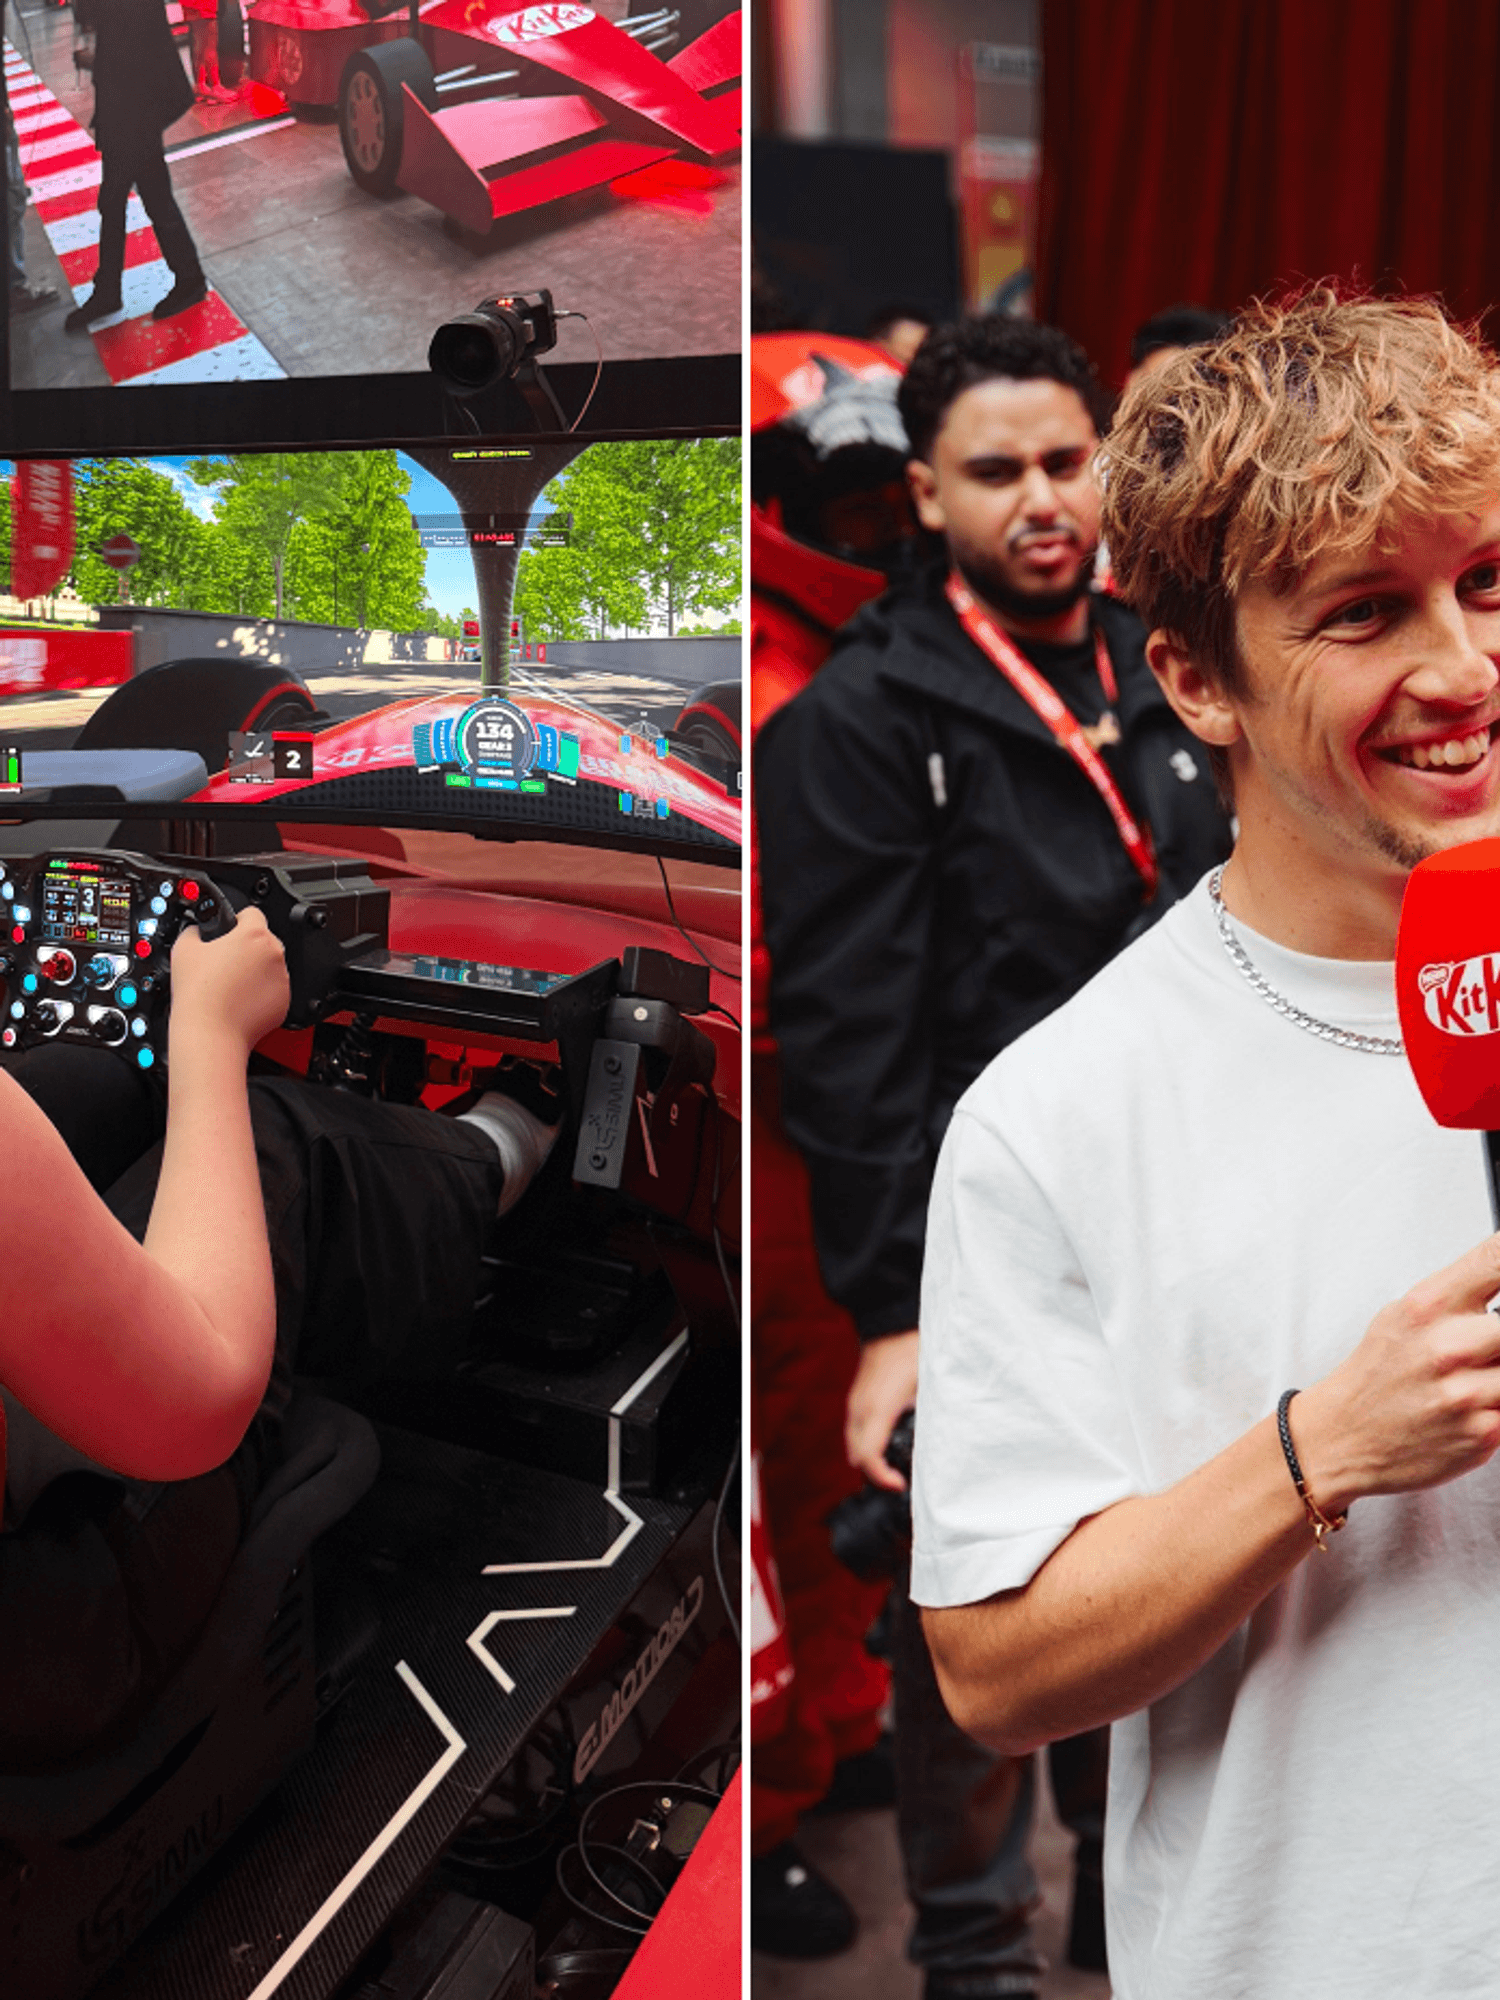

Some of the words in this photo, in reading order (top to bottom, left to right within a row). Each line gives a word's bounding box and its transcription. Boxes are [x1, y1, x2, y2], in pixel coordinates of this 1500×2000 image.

[506, 5, 586, 41] KitKat
[476, 722, 514, 741] 134
[286, 749, 302, 769] 2
[82, 888, 95, 907] 3
